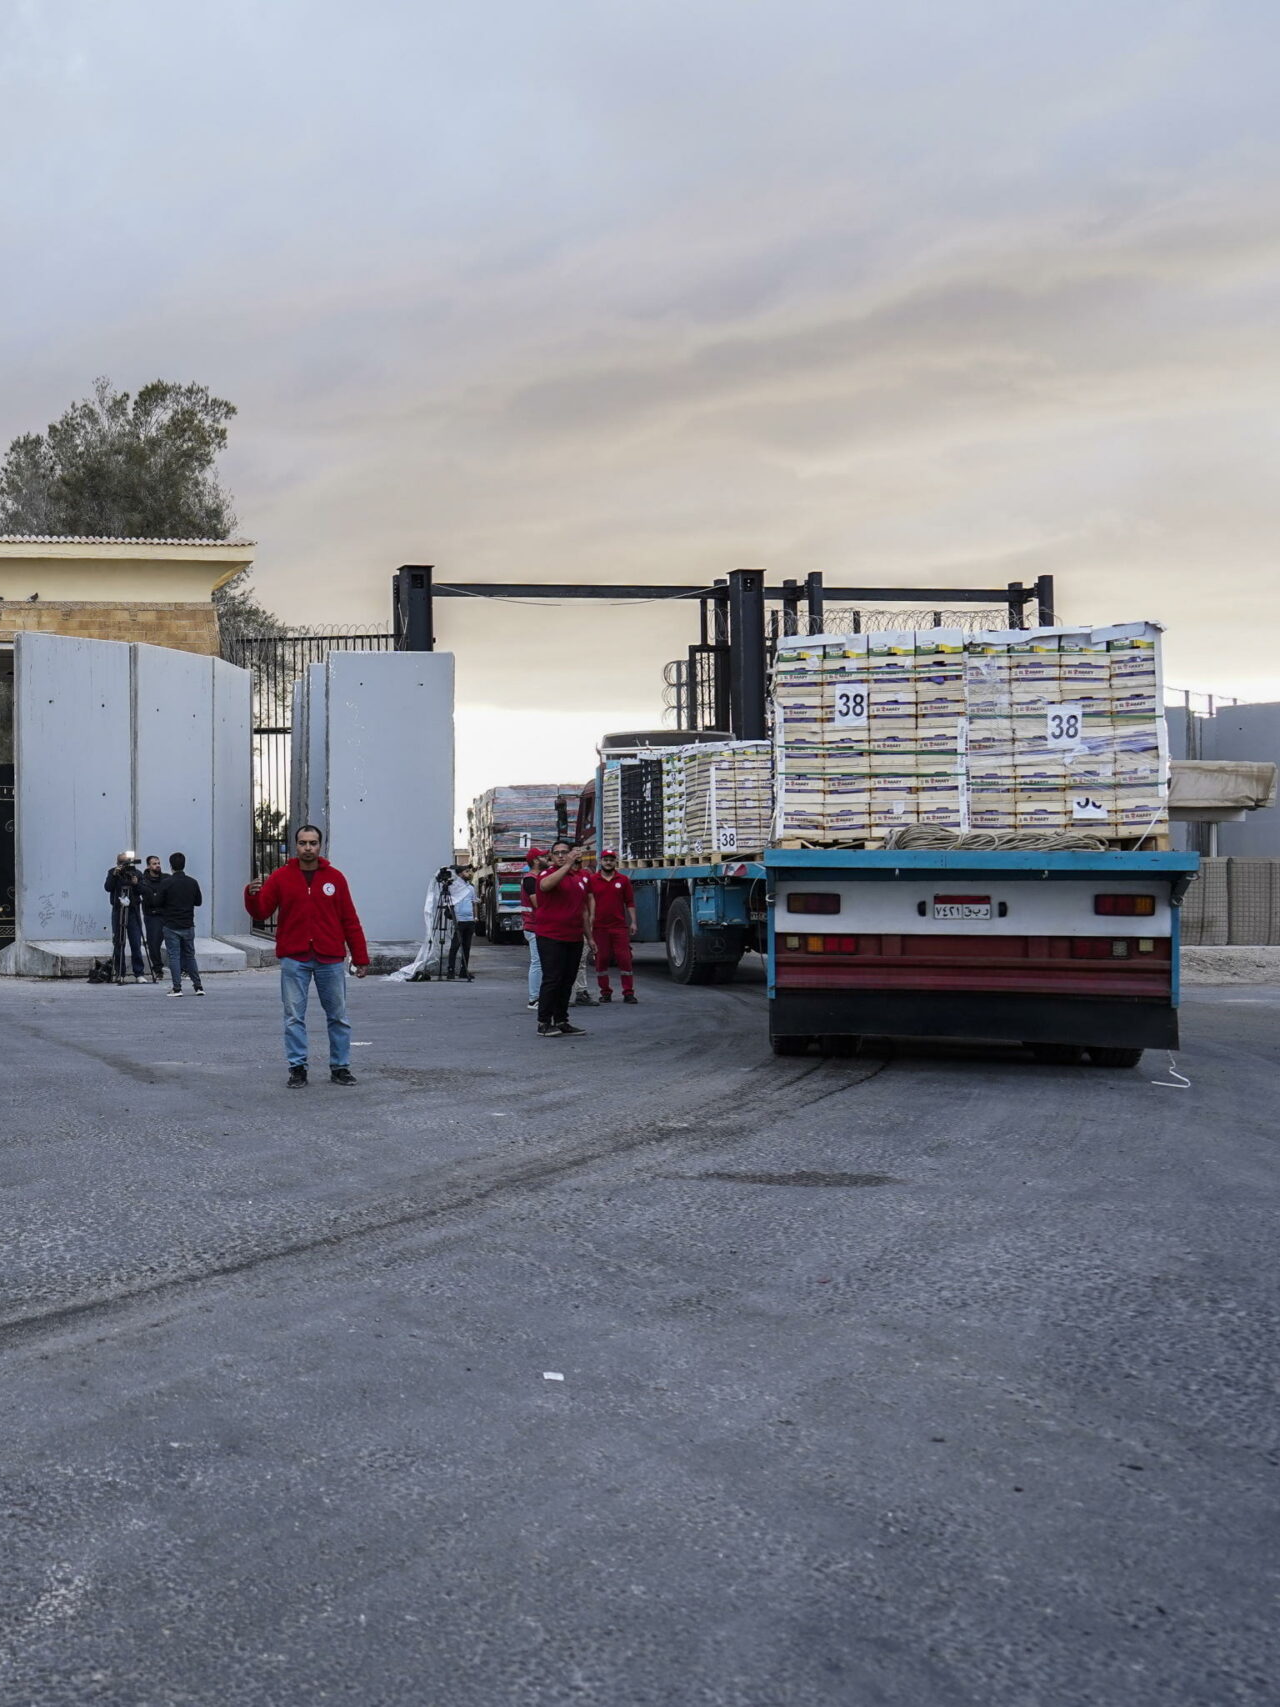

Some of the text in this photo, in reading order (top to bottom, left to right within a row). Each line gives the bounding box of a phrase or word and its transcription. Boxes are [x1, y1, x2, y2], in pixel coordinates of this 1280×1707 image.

[838, 693, 865, 717] 38
[1051, 714, 1079, 740] 38
[522, 834, 528, 848] 1
[721, 833, 736, 847] 38
